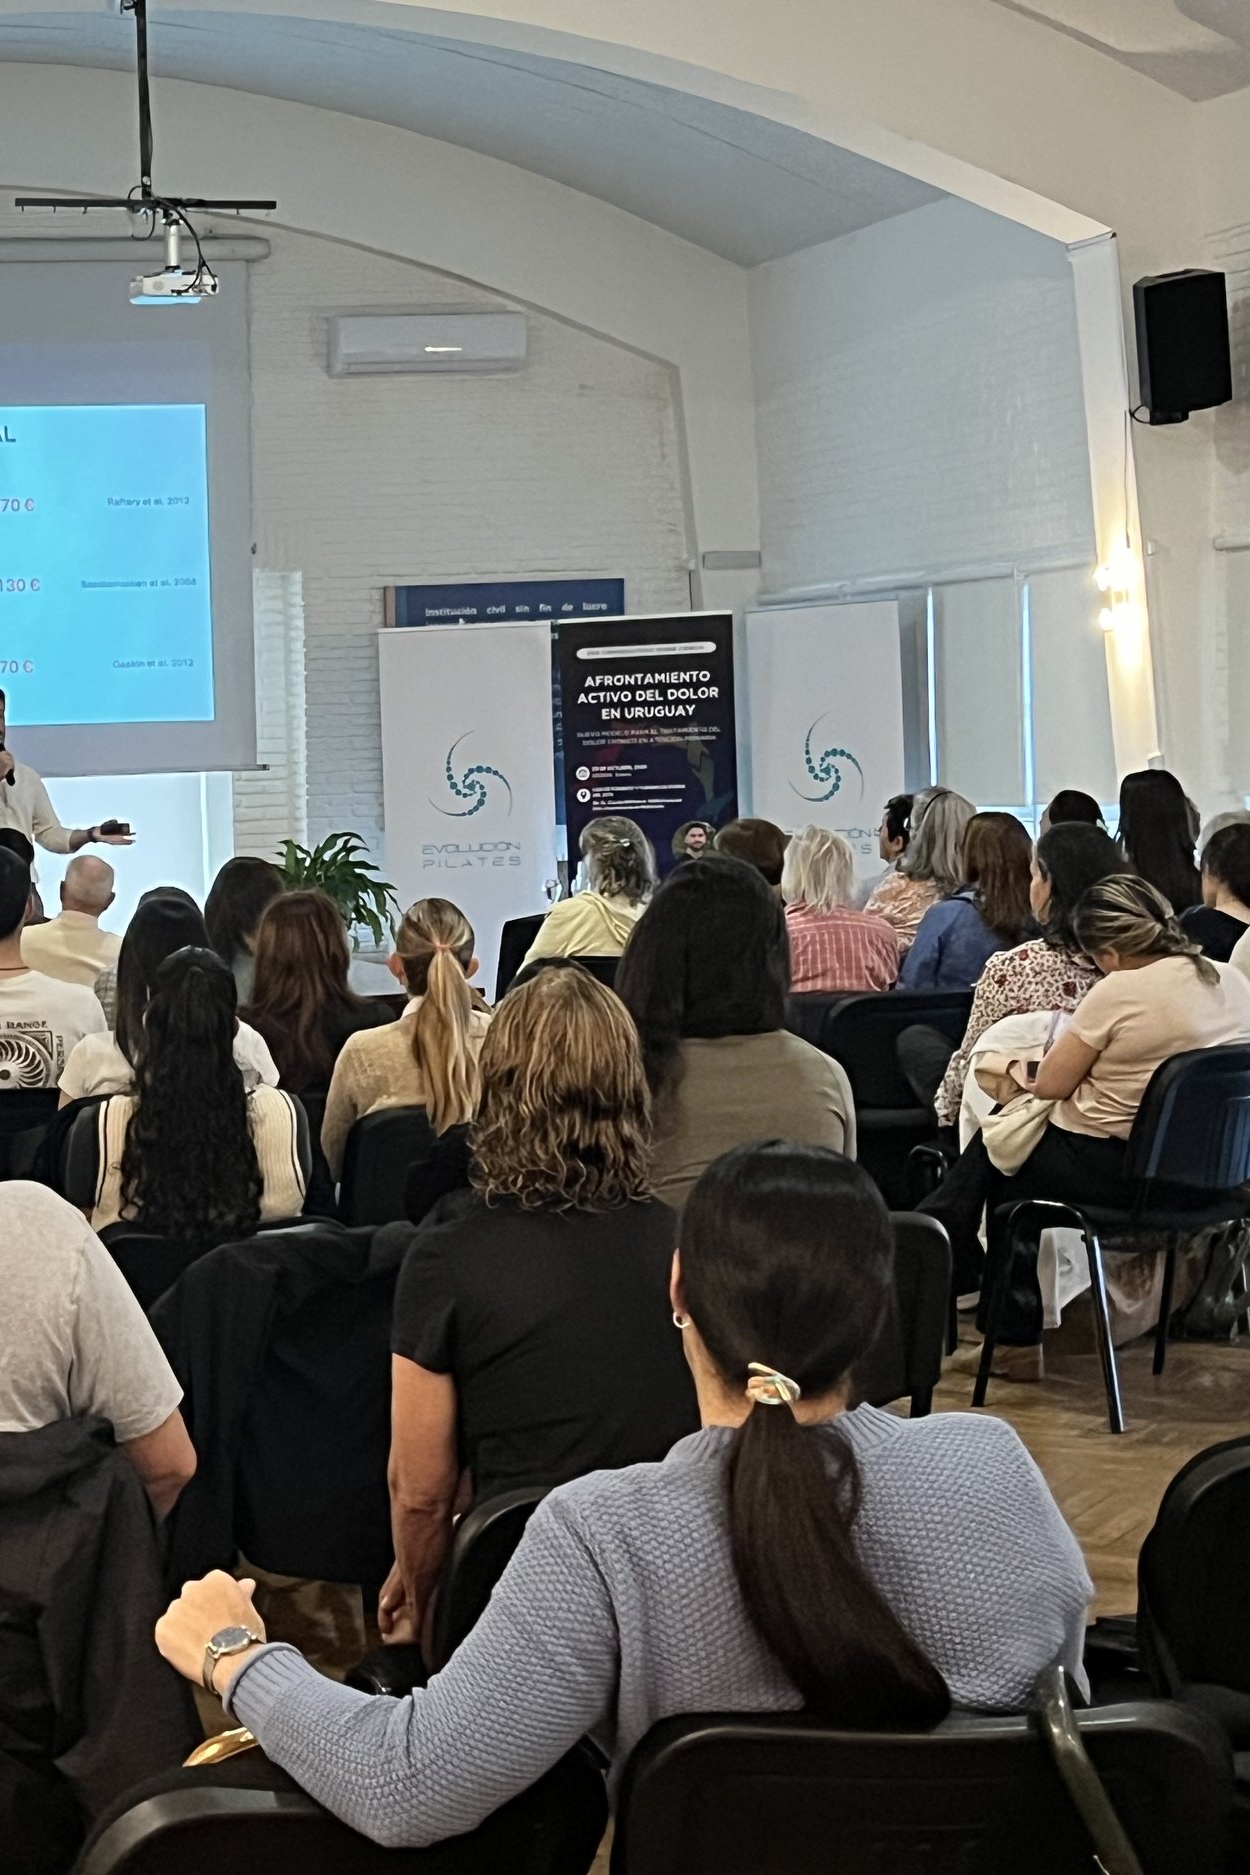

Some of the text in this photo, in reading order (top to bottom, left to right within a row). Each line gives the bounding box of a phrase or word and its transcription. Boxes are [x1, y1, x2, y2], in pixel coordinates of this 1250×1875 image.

[24, 498, 35, 512] €
[30, 578, 41, 592] €
[425, 602, 607, 617] Institución civil sin fin de lucro
[23, 660, 34, 673] €
[584, 670, 711, 688] AFRONTAMIENTO
[577, 686, 719, 704] ACTIVO DEL DOLOR
[601, 704, 696, 720] EN URUGUAY
[422, 856, 521, 869] PILATES
[7, 1020, 48, 1029] RANGE
